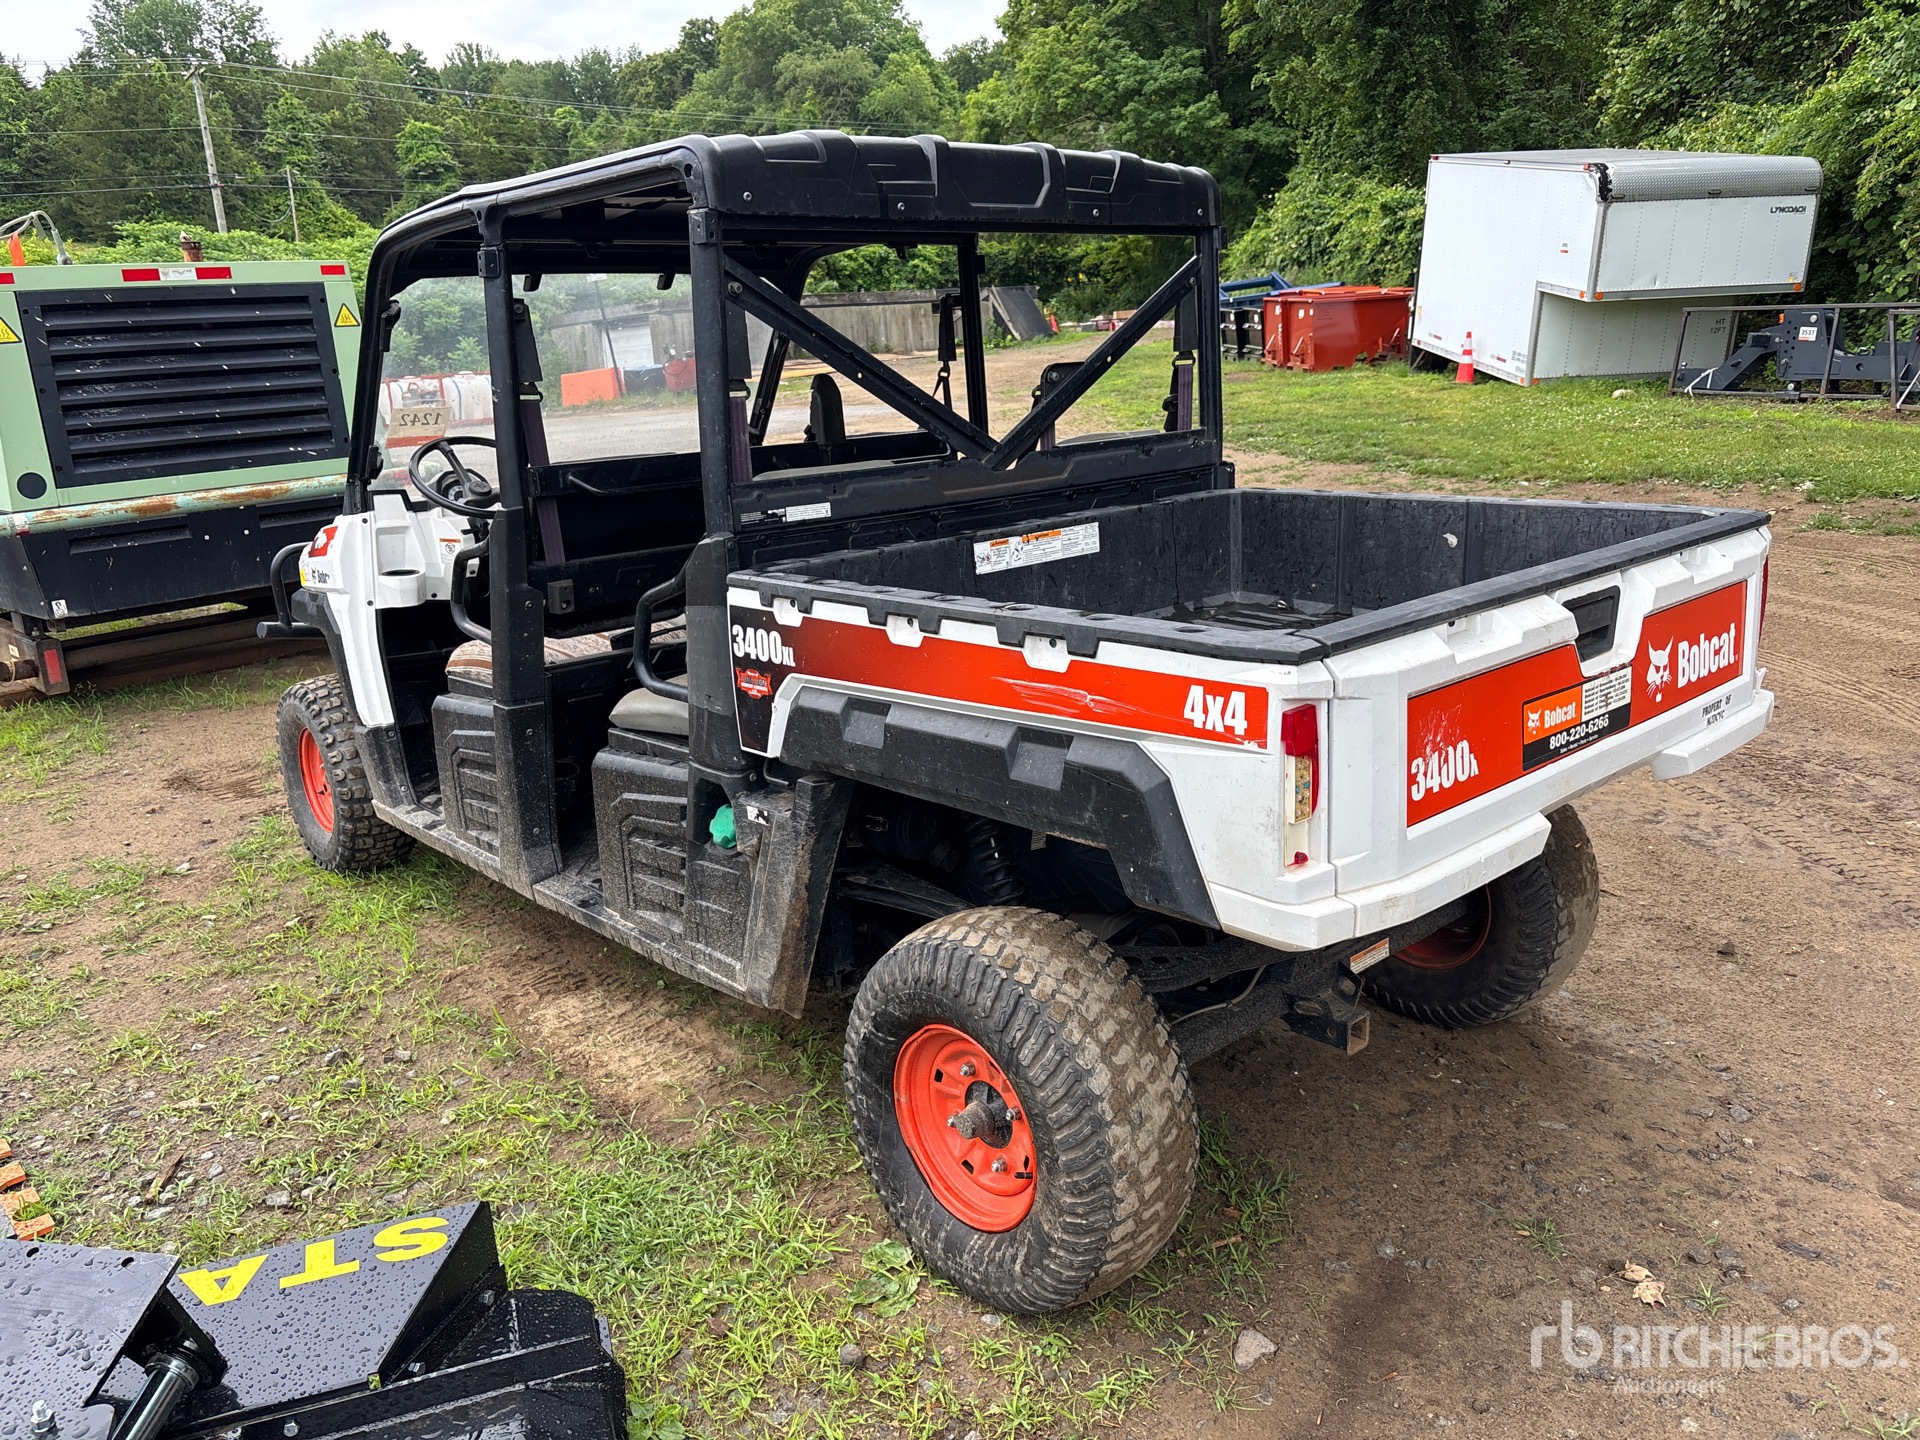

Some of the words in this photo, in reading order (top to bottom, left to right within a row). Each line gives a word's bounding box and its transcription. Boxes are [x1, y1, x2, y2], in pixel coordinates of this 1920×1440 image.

[1770, 205, 1807, 214] LYNCOACH
[1716, 318, 1726, 326] HT
[732, 624, 797, 667] 3400XL
[1678, 622, 1736, 689] Bobcat
[1183, 684, 1248, 736] 4x4
[1544, 701, 1577, 729] Bobcat
